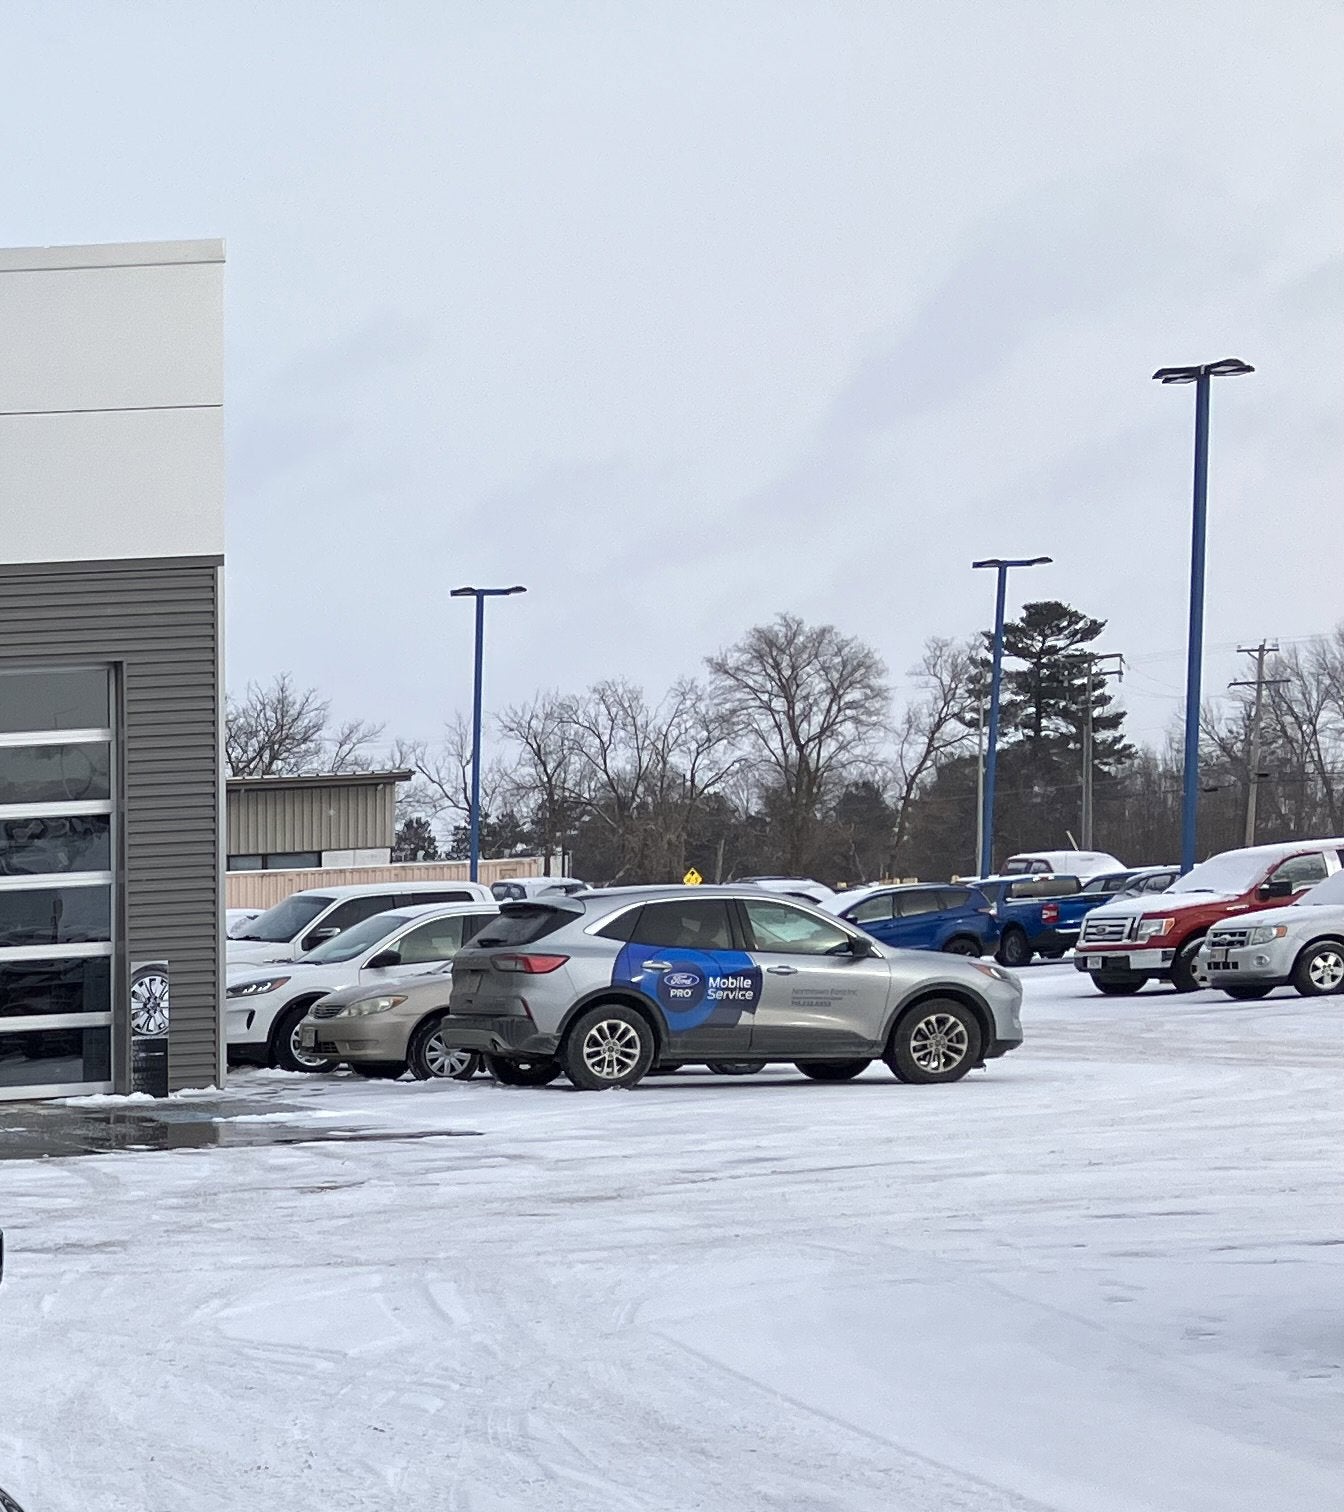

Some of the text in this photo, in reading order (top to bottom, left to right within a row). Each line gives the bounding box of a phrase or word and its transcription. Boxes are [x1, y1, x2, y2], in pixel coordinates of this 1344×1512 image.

[670, 975, 693, 985] Ford
[708, 976, 752, 988] Mobile
[670, 988, 692, 998] PRO
[707, 988, 754, 1000] Service
